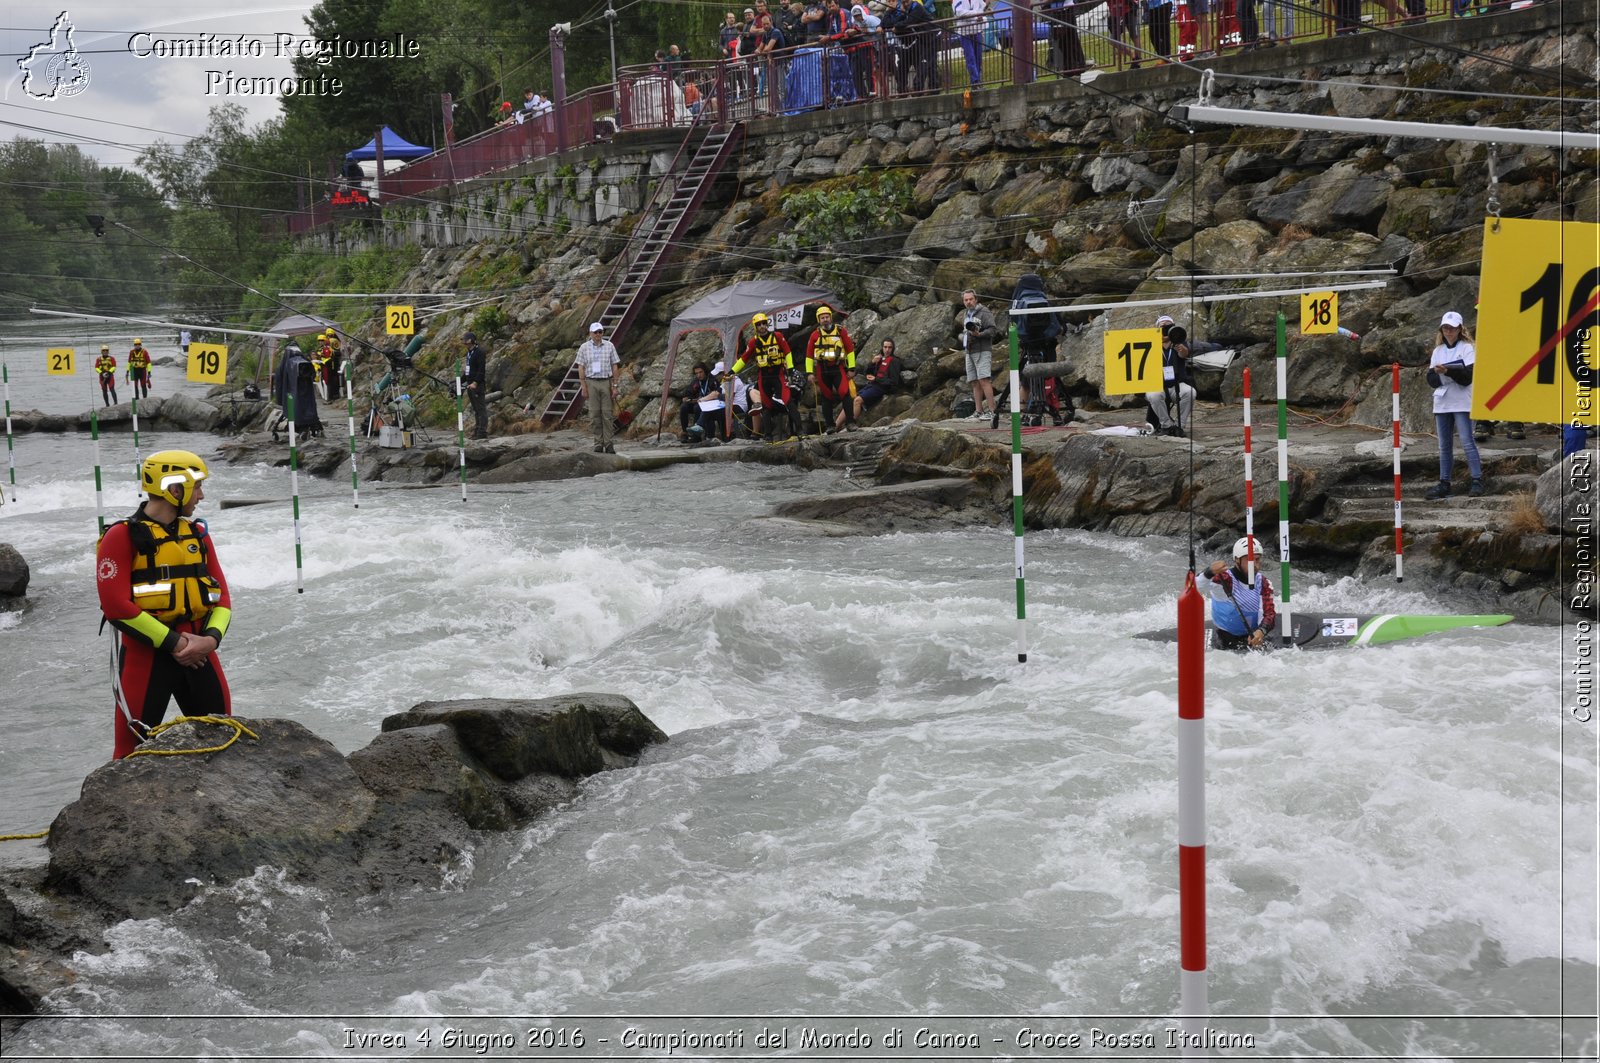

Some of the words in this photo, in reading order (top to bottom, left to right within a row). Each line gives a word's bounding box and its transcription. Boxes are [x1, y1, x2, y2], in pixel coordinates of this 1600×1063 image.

[390, 311, 411, 327] 20
[777, 313, 788, 322] 23
[790, 309, 801, 318] 24
[1309, 299, 1331, 325] 18
[52, 353, 71, 370] 21
[196, 350, 220, 375] 19
[1118, 341, 1152, 382] 17
[1334, 619, 1345, 635] CAN
